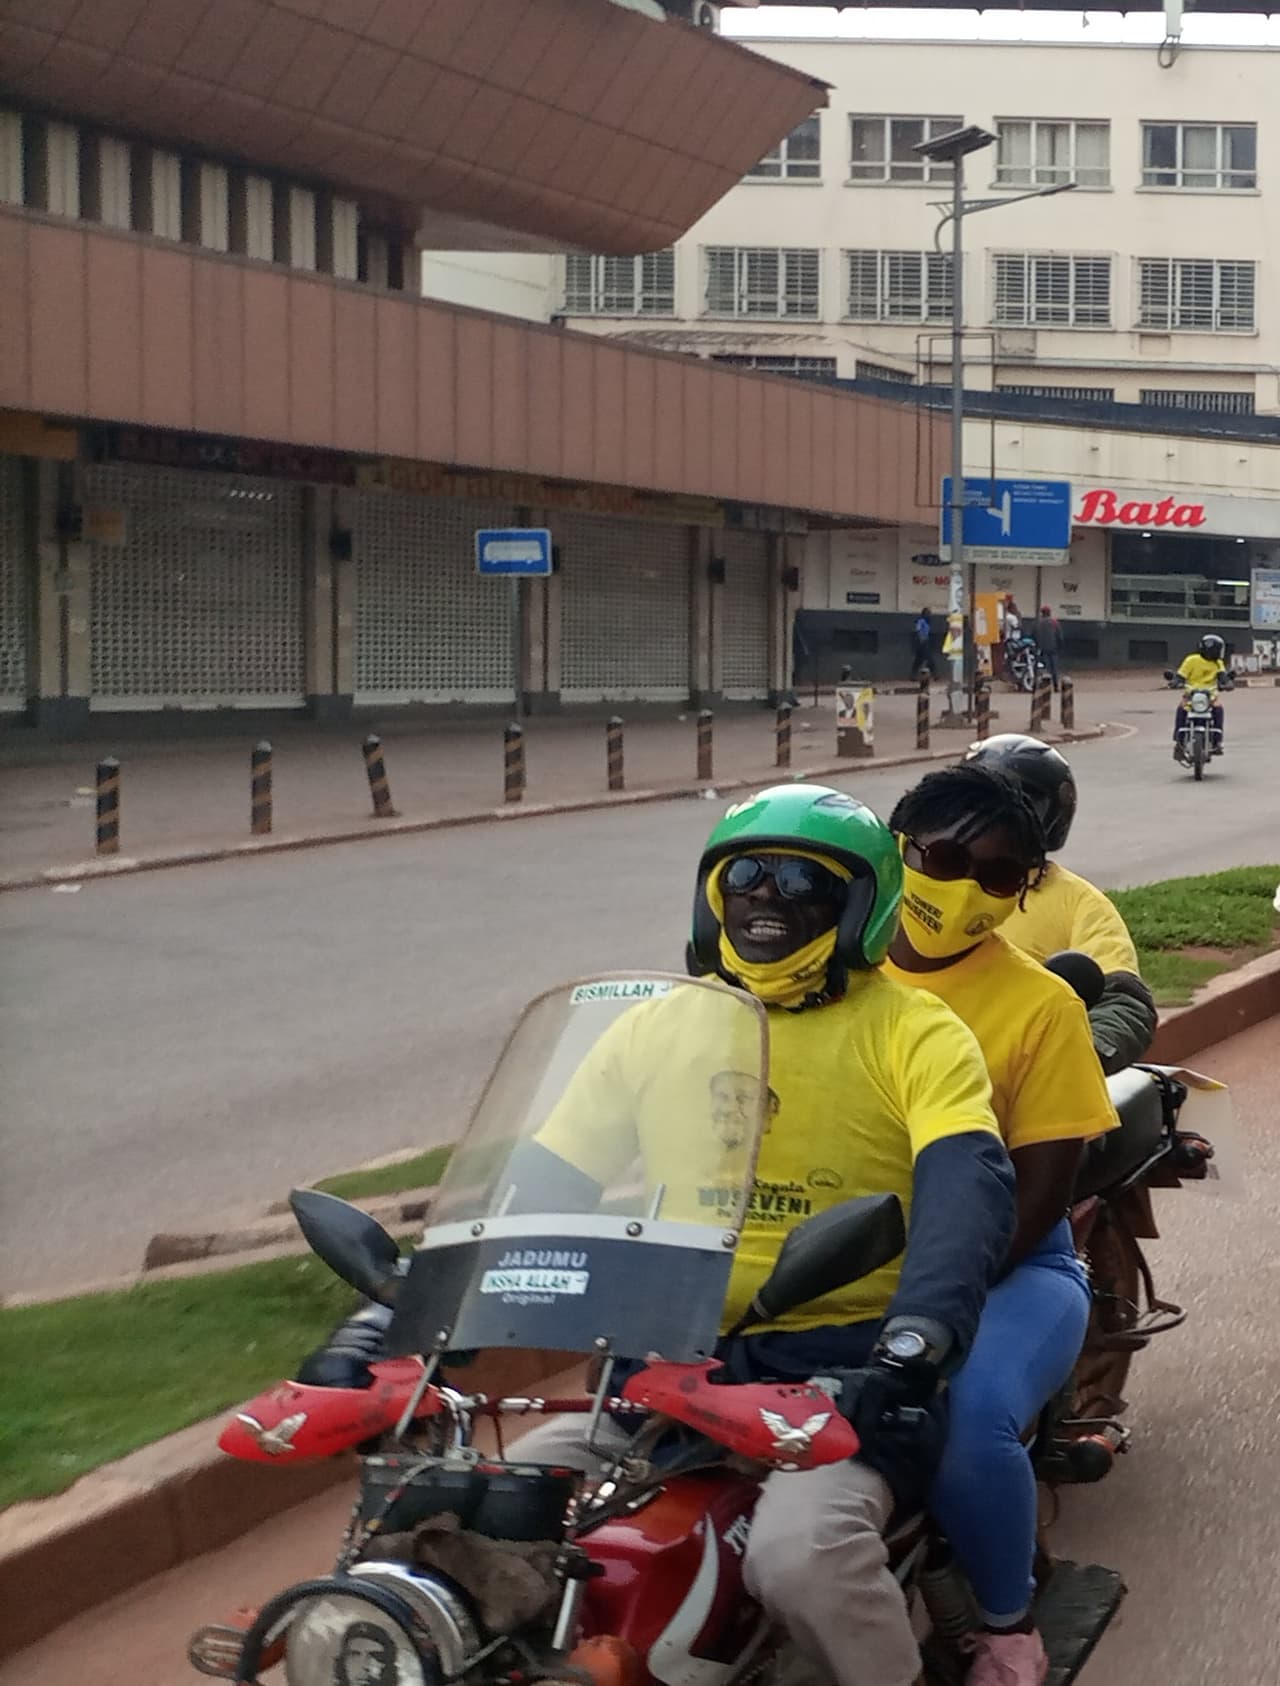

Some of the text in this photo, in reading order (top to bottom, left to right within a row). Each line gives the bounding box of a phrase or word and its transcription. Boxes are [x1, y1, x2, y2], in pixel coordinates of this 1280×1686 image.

[1073, 489, 1206, 528] Bata
[575, 983, 655, 1001] BISMILLAH
[498, 1250, 588, 1268] JADUMU
